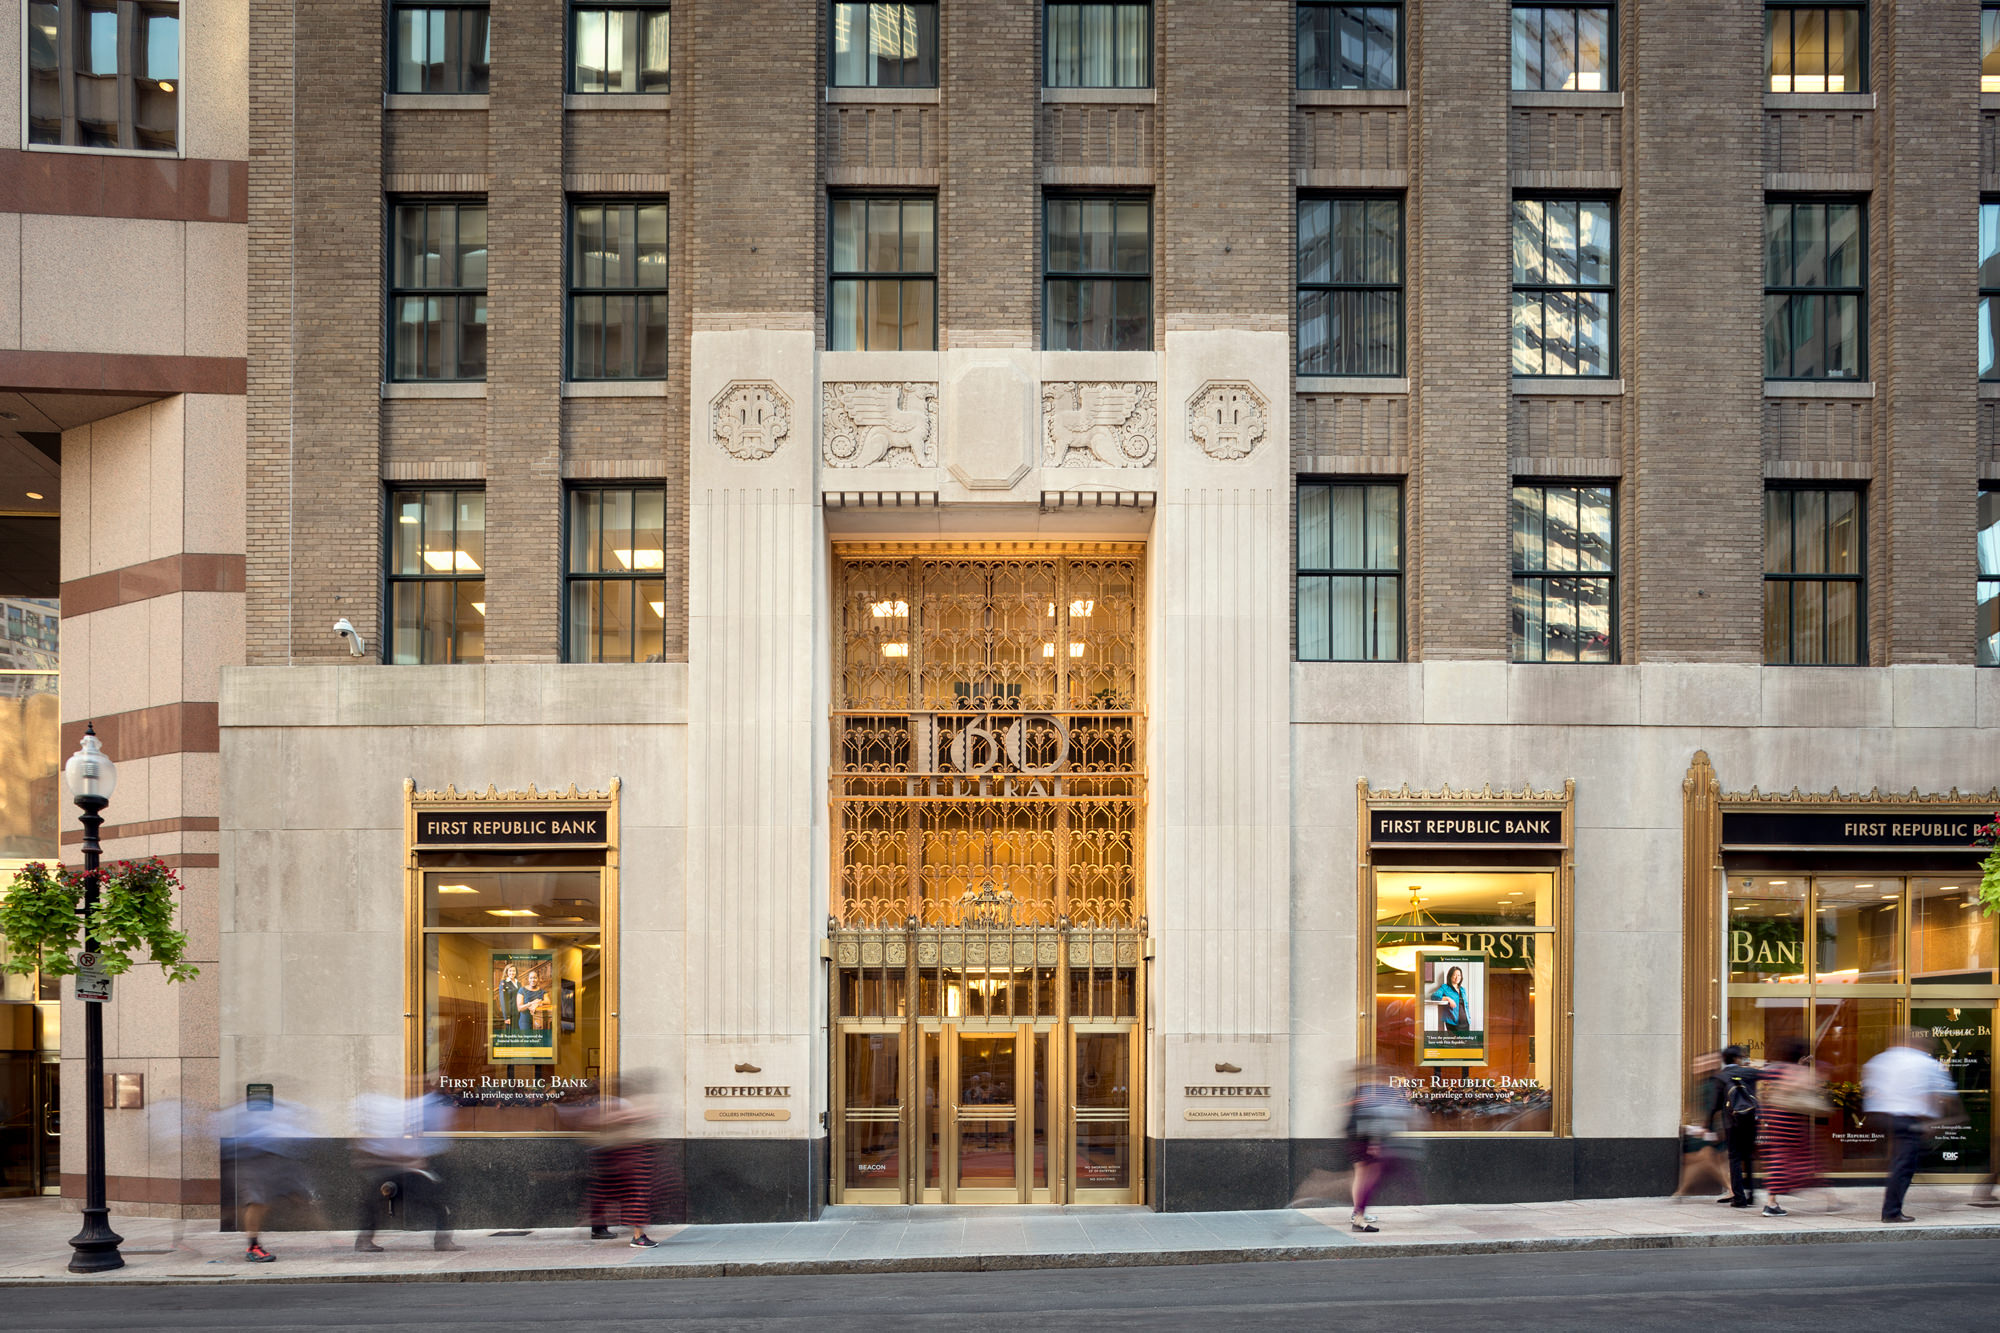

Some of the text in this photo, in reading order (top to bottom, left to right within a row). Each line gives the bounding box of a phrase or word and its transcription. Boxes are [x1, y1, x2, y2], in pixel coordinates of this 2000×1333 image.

[907, 713, 1070, 774] 160
[906, 775, 1070, 797] FEDERAL
[427, 820, 597, 835] FIRST REPUBLIC BANK
[1380, 819, 1551, 834] FIRST REPUBLIC BANK
[1844, 823, 1887, 836] FIRST
[1892, 823, 1968, 837] REPUBLIC
[1910, 1030, 1930, 1038] IRST
[1977, 1025, 1992, 1036] BA
[439, 1075, 589, 1088] FIRST REPUBLIC BANK
[1388, 1075, 1538, 1088] FIRST REPUBLIC BANK
[463, 1091, 474, 1099] It's
[481, 1091, 514, 1101] privilege
[704, 1086, 791, 1097] 160 FEDERAL
[1184, 1086, 1271, 1097] 160 FEDERAL
[1412, 1091, 1424, 1099] It's
[1430, 1091, 1463, 1101] privilege
[1942, 1151, 1959, 1159] FDIC
